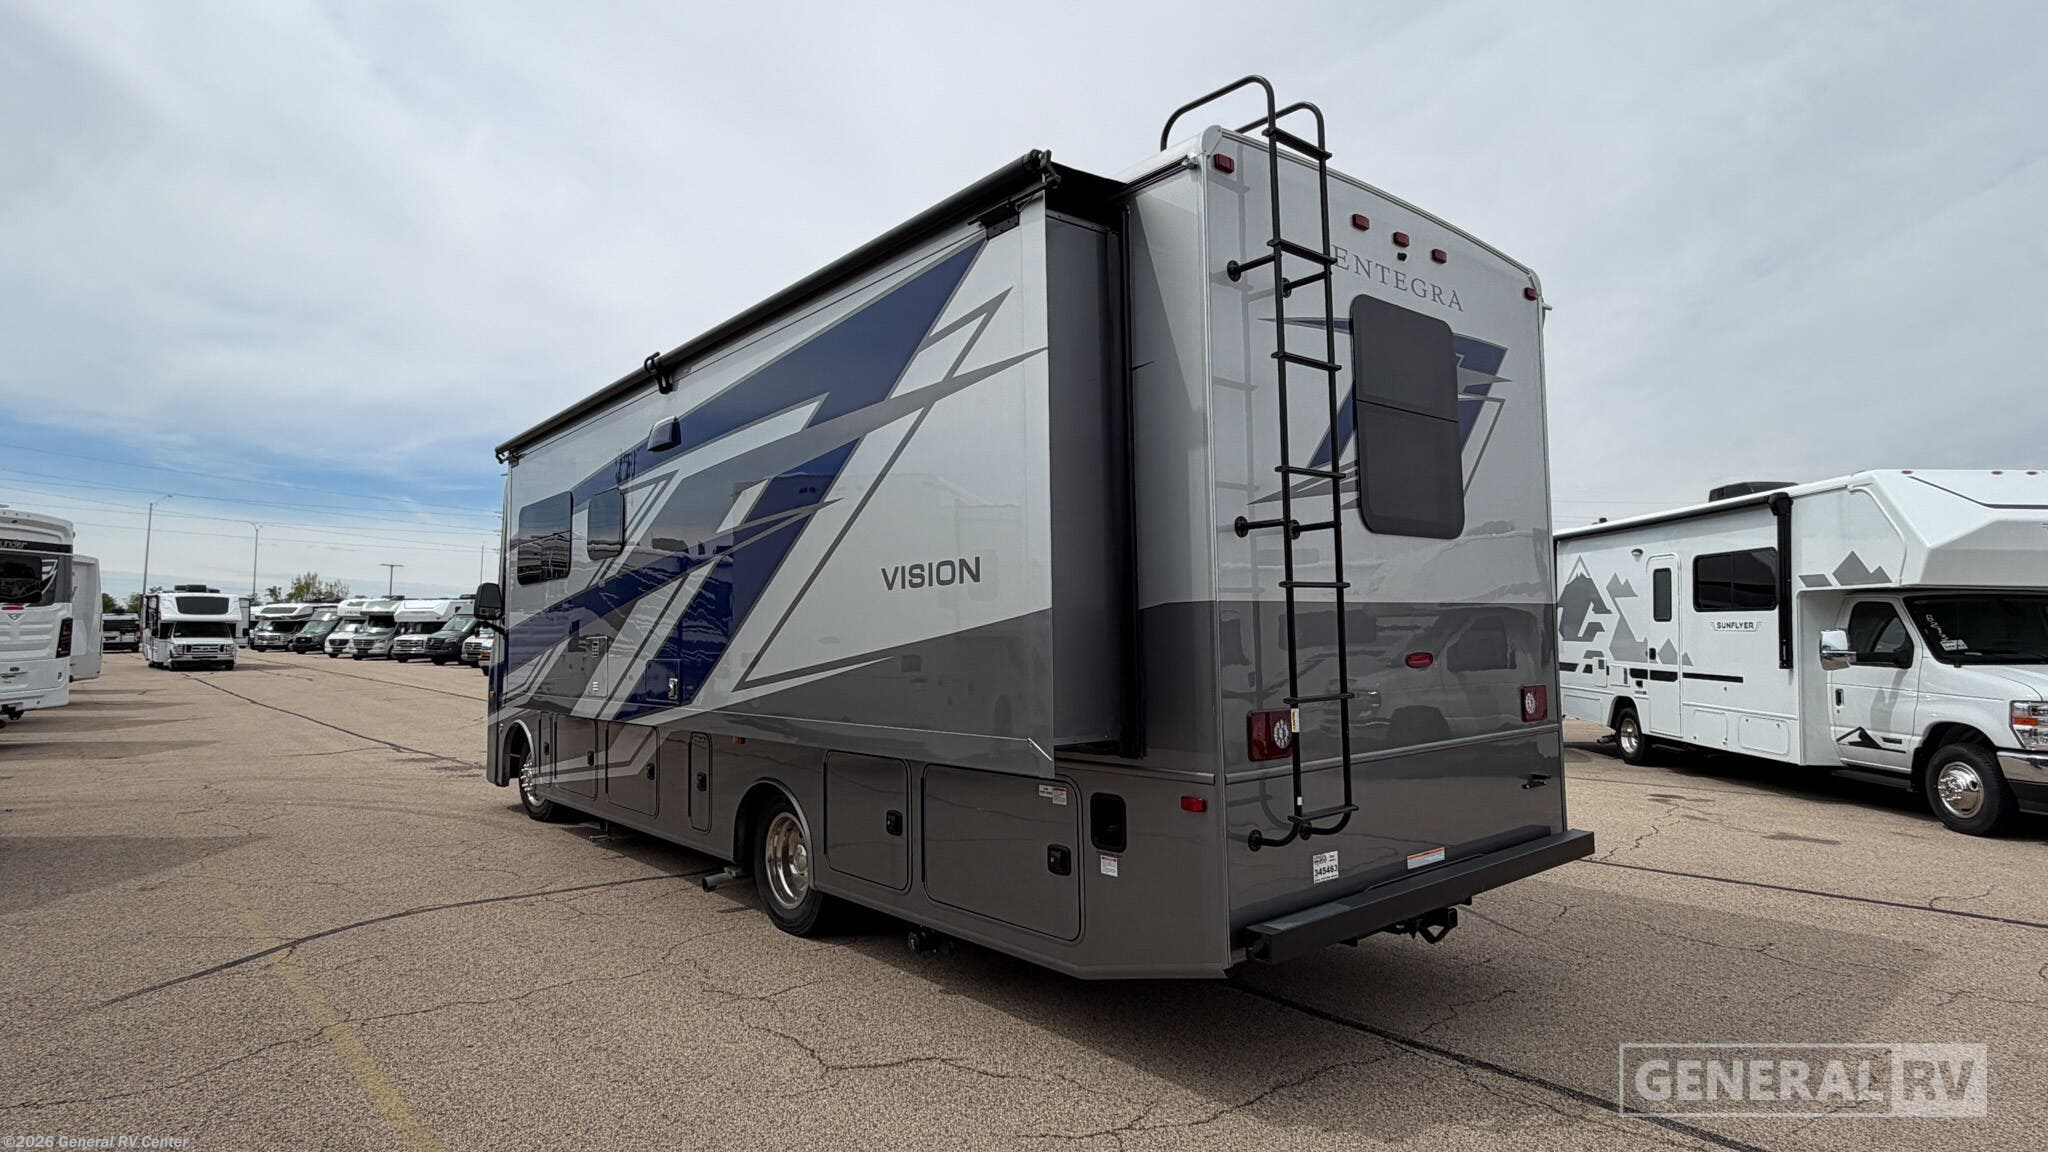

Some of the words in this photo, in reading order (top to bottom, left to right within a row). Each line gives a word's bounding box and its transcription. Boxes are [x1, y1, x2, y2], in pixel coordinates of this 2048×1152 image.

[1332, 244, 1464, 312] ENTEGRA
[881, 556, 980, 591] VISION
[1716, 621, 1754, 629] SUNFLYER
